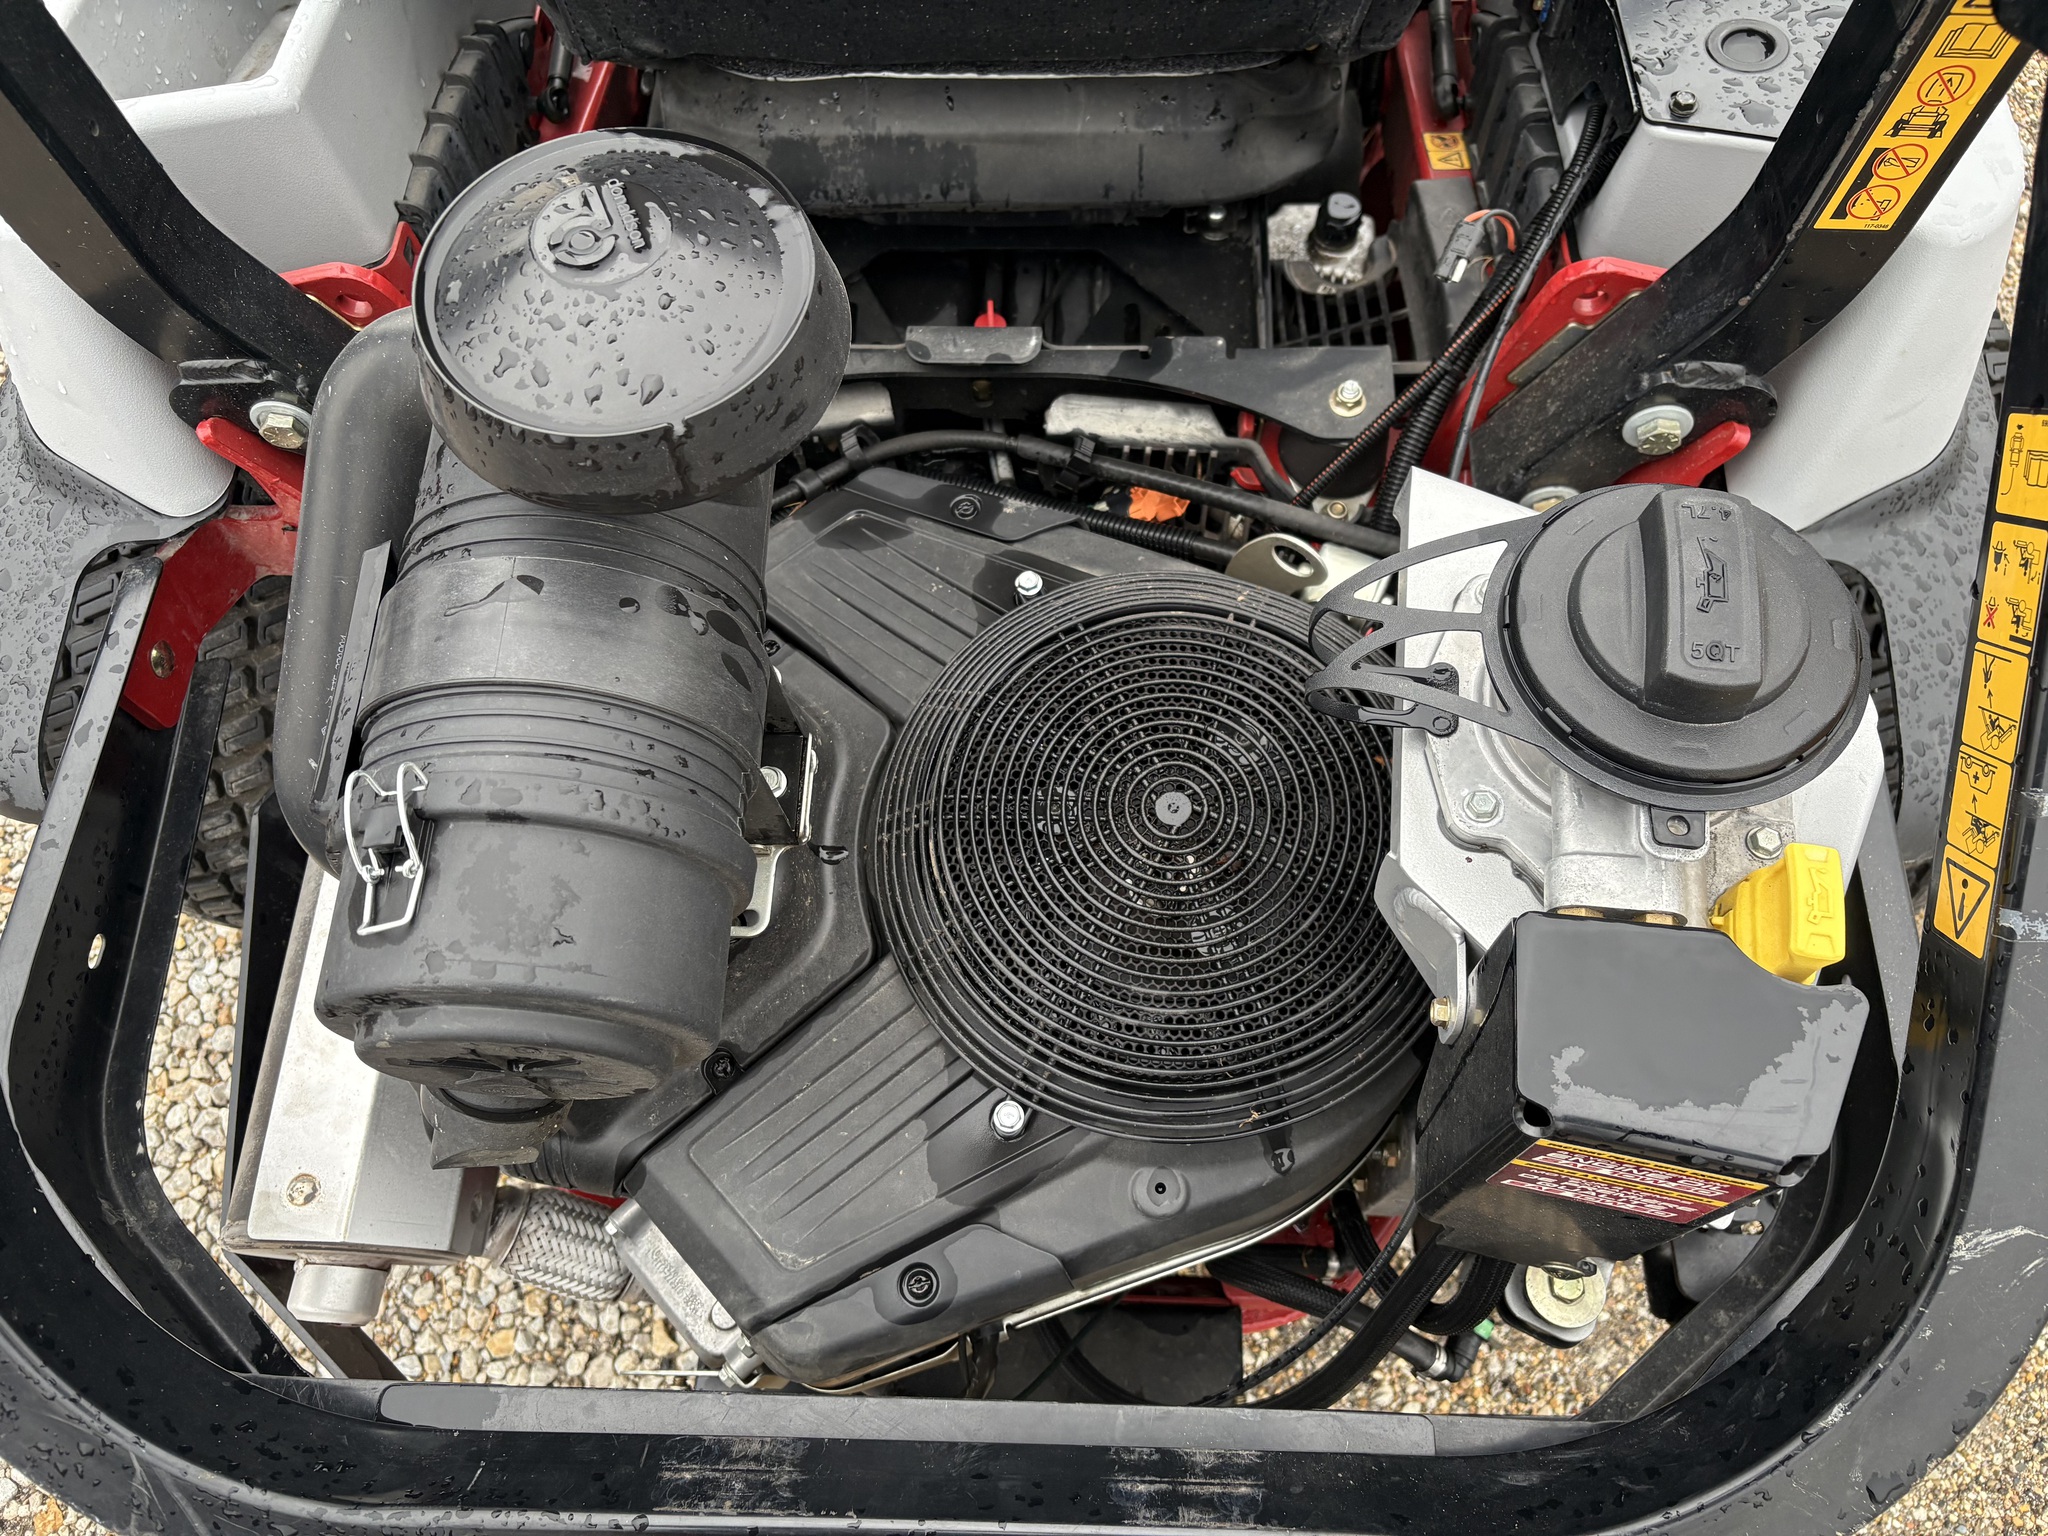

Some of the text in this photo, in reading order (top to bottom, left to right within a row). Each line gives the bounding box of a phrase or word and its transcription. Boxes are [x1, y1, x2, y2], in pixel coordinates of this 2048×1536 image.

[606, 179, 645, 249] donaldson
[1681, 504, 1732, 521] 4.7L
[1691, 641, 1740, 663] 5QT
[1547, 1151, 1672, 1180] ENGINE
[1677, 1179, 1731, 1194] OIL
